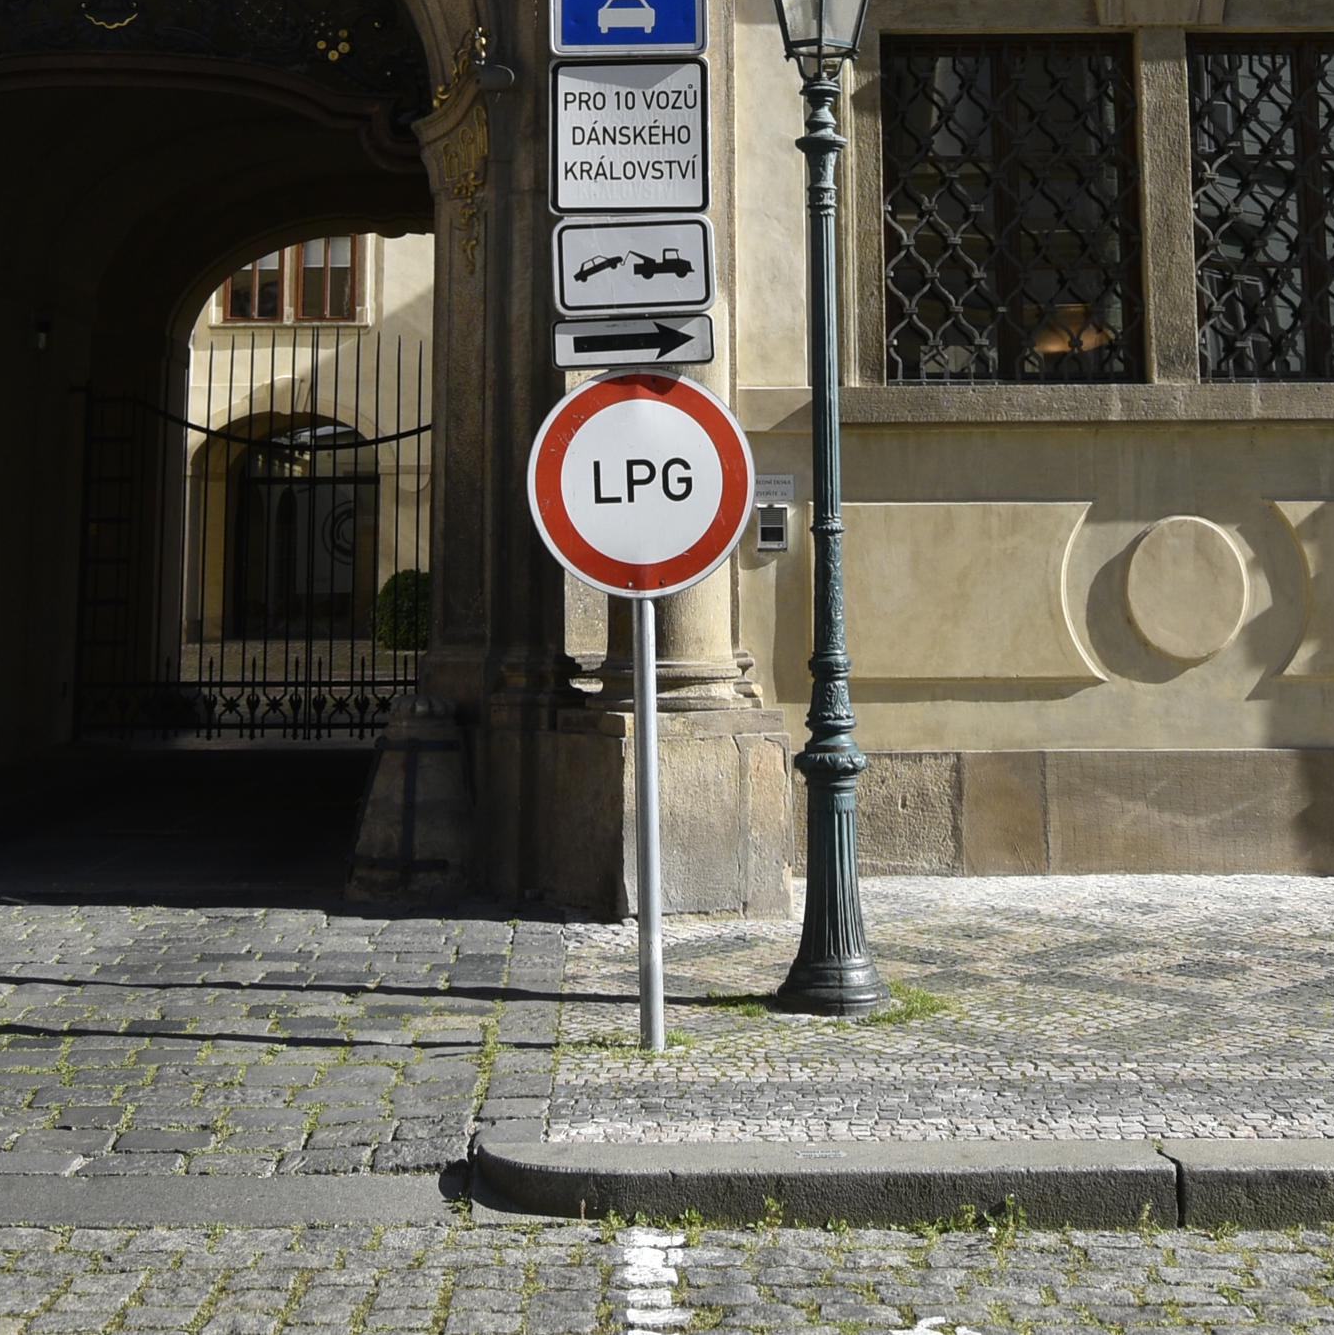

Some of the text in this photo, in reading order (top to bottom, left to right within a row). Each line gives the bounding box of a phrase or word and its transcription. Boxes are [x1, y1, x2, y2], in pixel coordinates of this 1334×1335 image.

[564, 83, 697, 111] PRO 10 VOZŮ
[572, 119, 691, 146] DÁNSKÉHO
[564, 154, 698, 181] KRÁLOVSTVÍ
[593, 457, 693, 504] LPG
